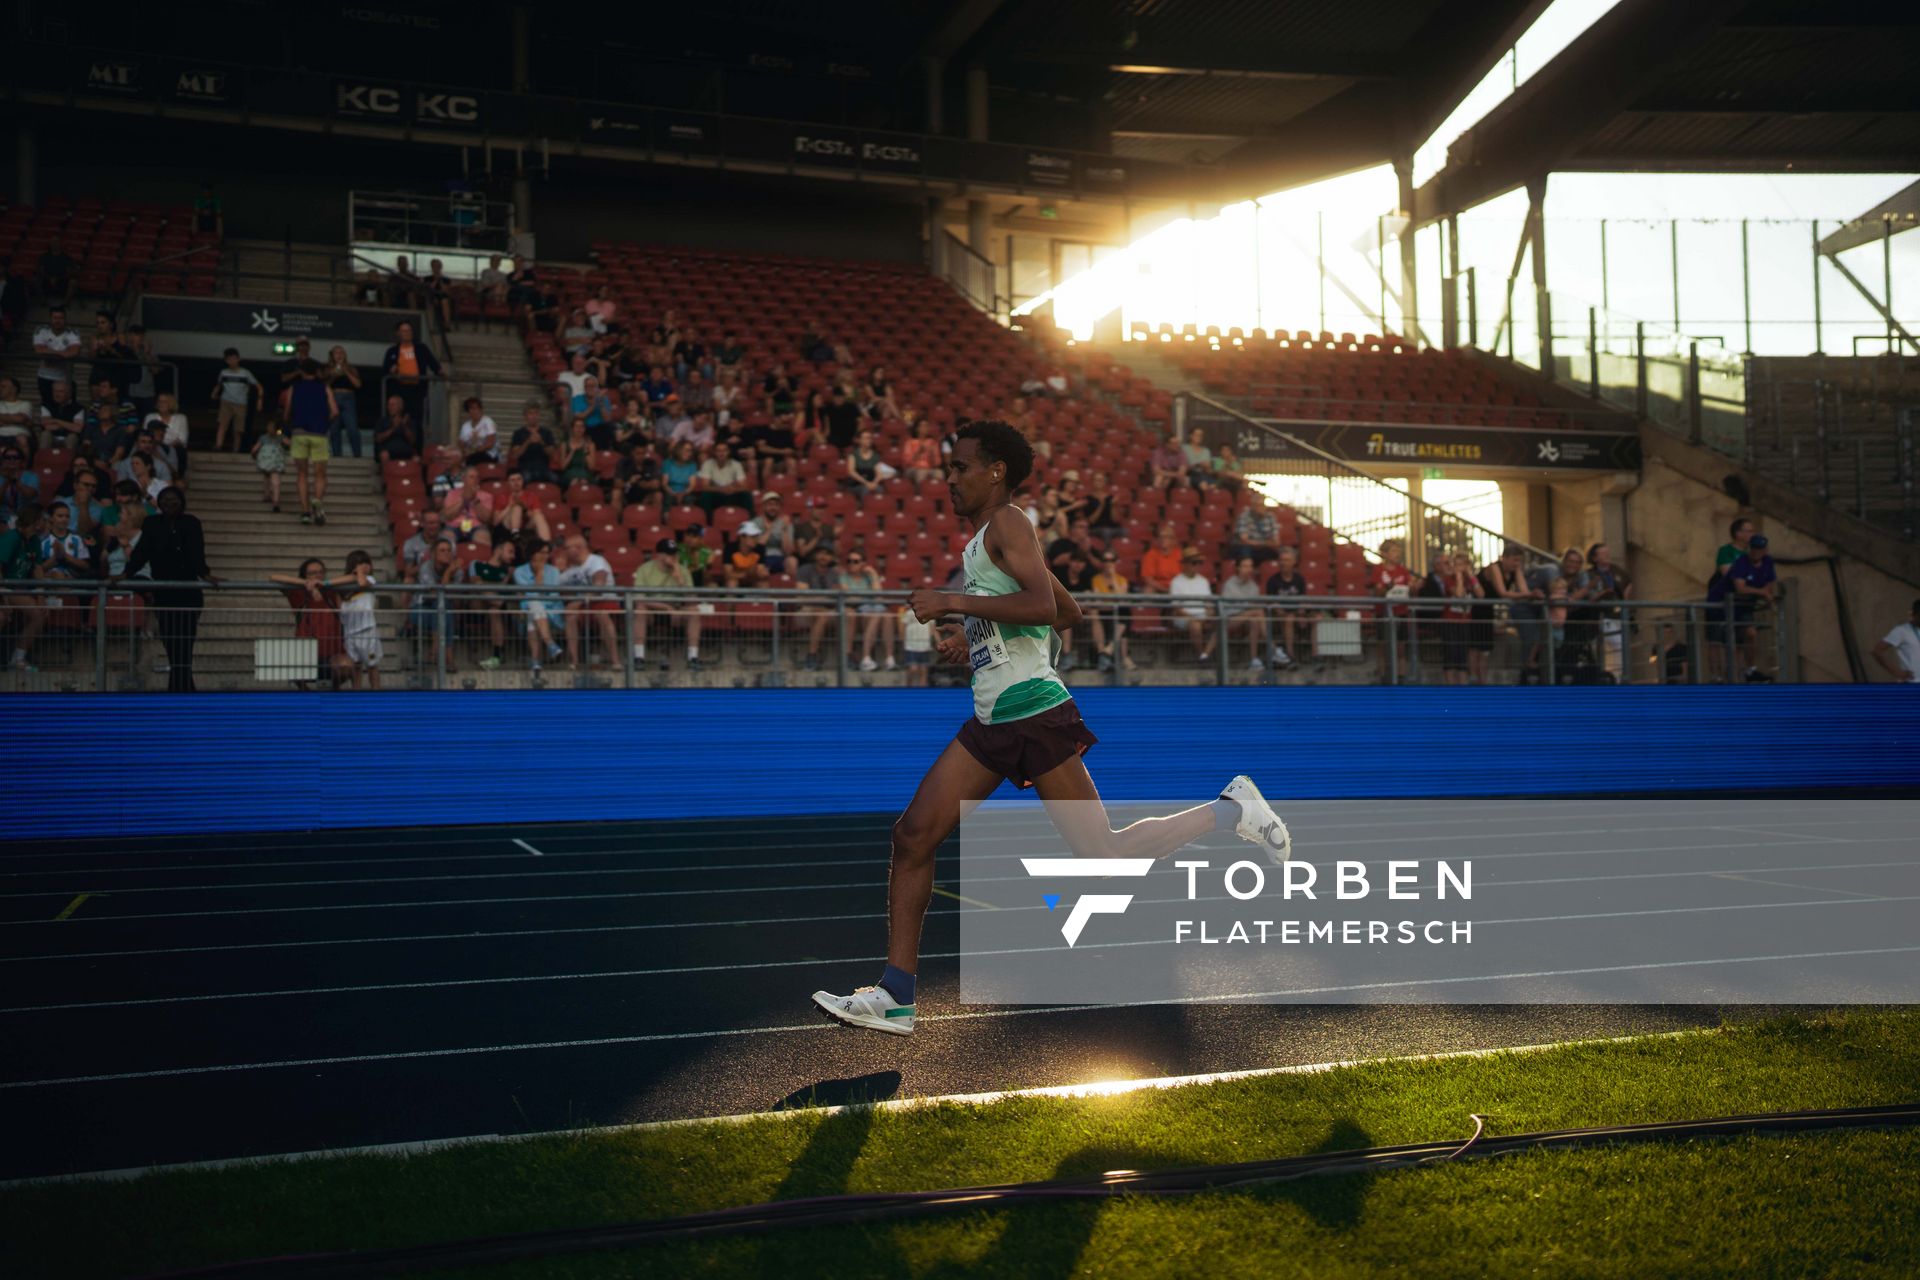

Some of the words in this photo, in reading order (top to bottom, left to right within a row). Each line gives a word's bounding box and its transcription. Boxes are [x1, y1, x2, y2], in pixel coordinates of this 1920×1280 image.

[341, 7, 441, 29] KOSATEC
[337, 85, 400, 113] KC
[416, 93, 479, 121] KC
